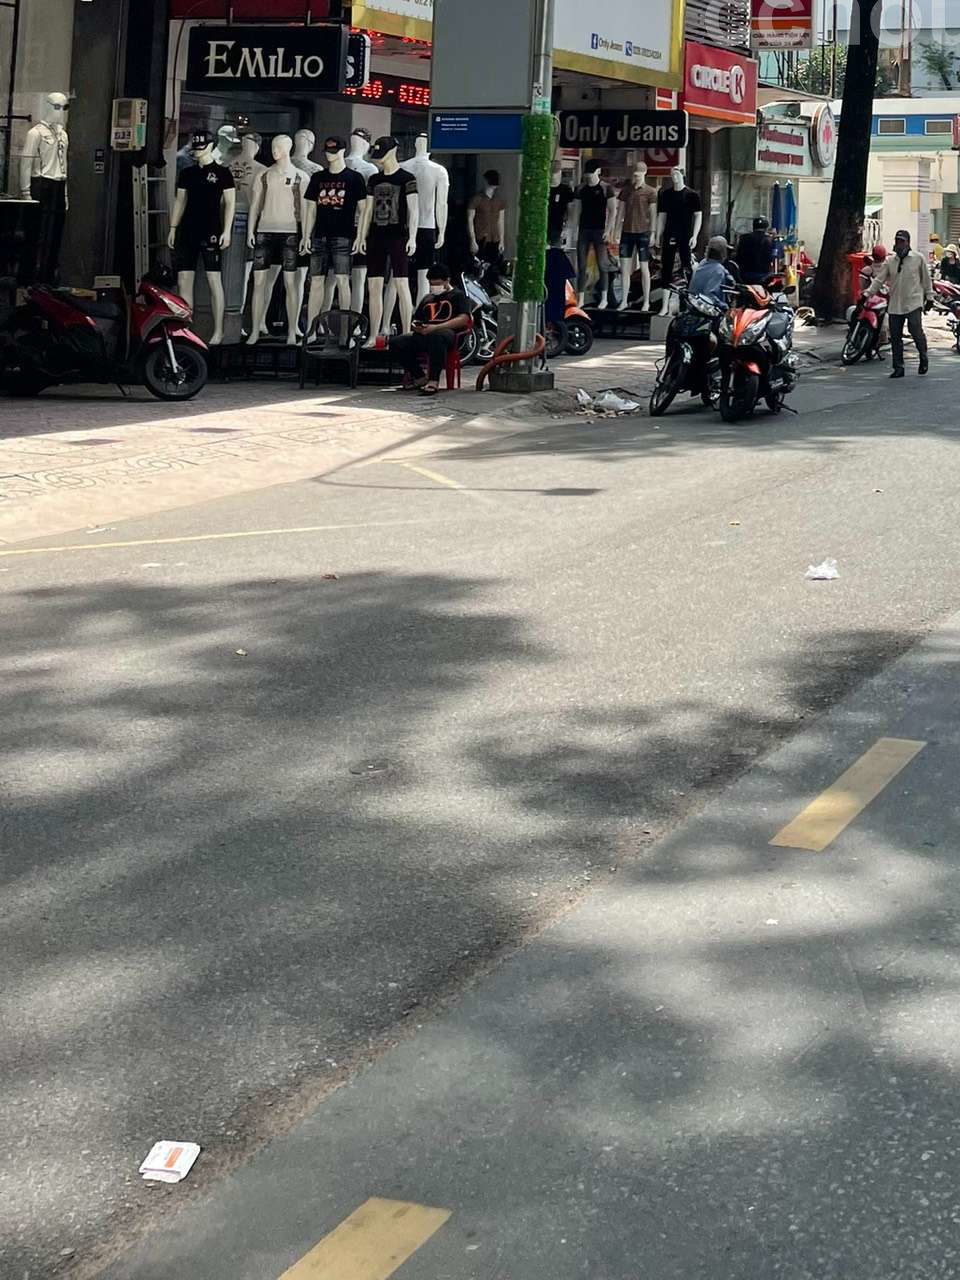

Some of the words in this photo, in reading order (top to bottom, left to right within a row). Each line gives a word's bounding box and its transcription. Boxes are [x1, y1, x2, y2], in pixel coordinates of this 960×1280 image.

[204, 40, 324, 78] EMILIO
[691, 64, 730, 93] CIRCLE
[565, 115, 610, 144] Only
[617, 115, 678, 141] Jeans
